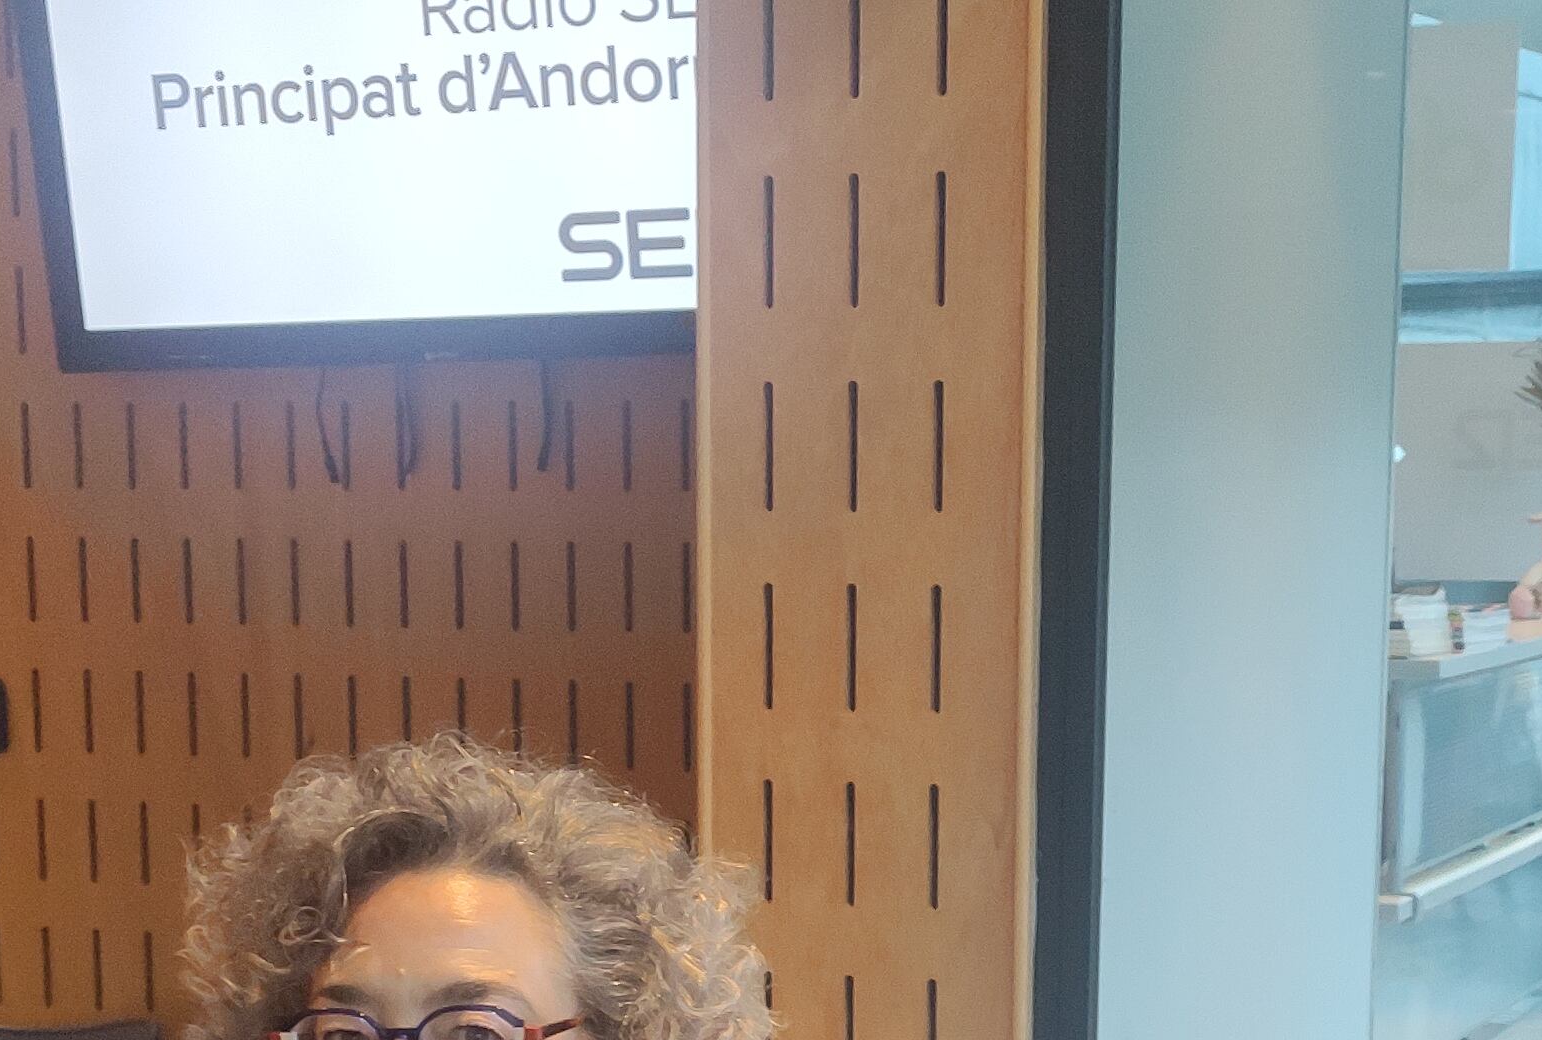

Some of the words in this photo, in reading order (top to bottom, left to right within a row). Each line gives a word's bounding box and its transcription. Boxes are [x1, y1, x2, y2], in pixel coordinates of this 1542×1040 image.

[421, 0, 598, 36] Radio
[150, 62, 422, 136] Principat
[438, 45, 698, 114] d'Andor
[558, 207, 693, 282] SE
